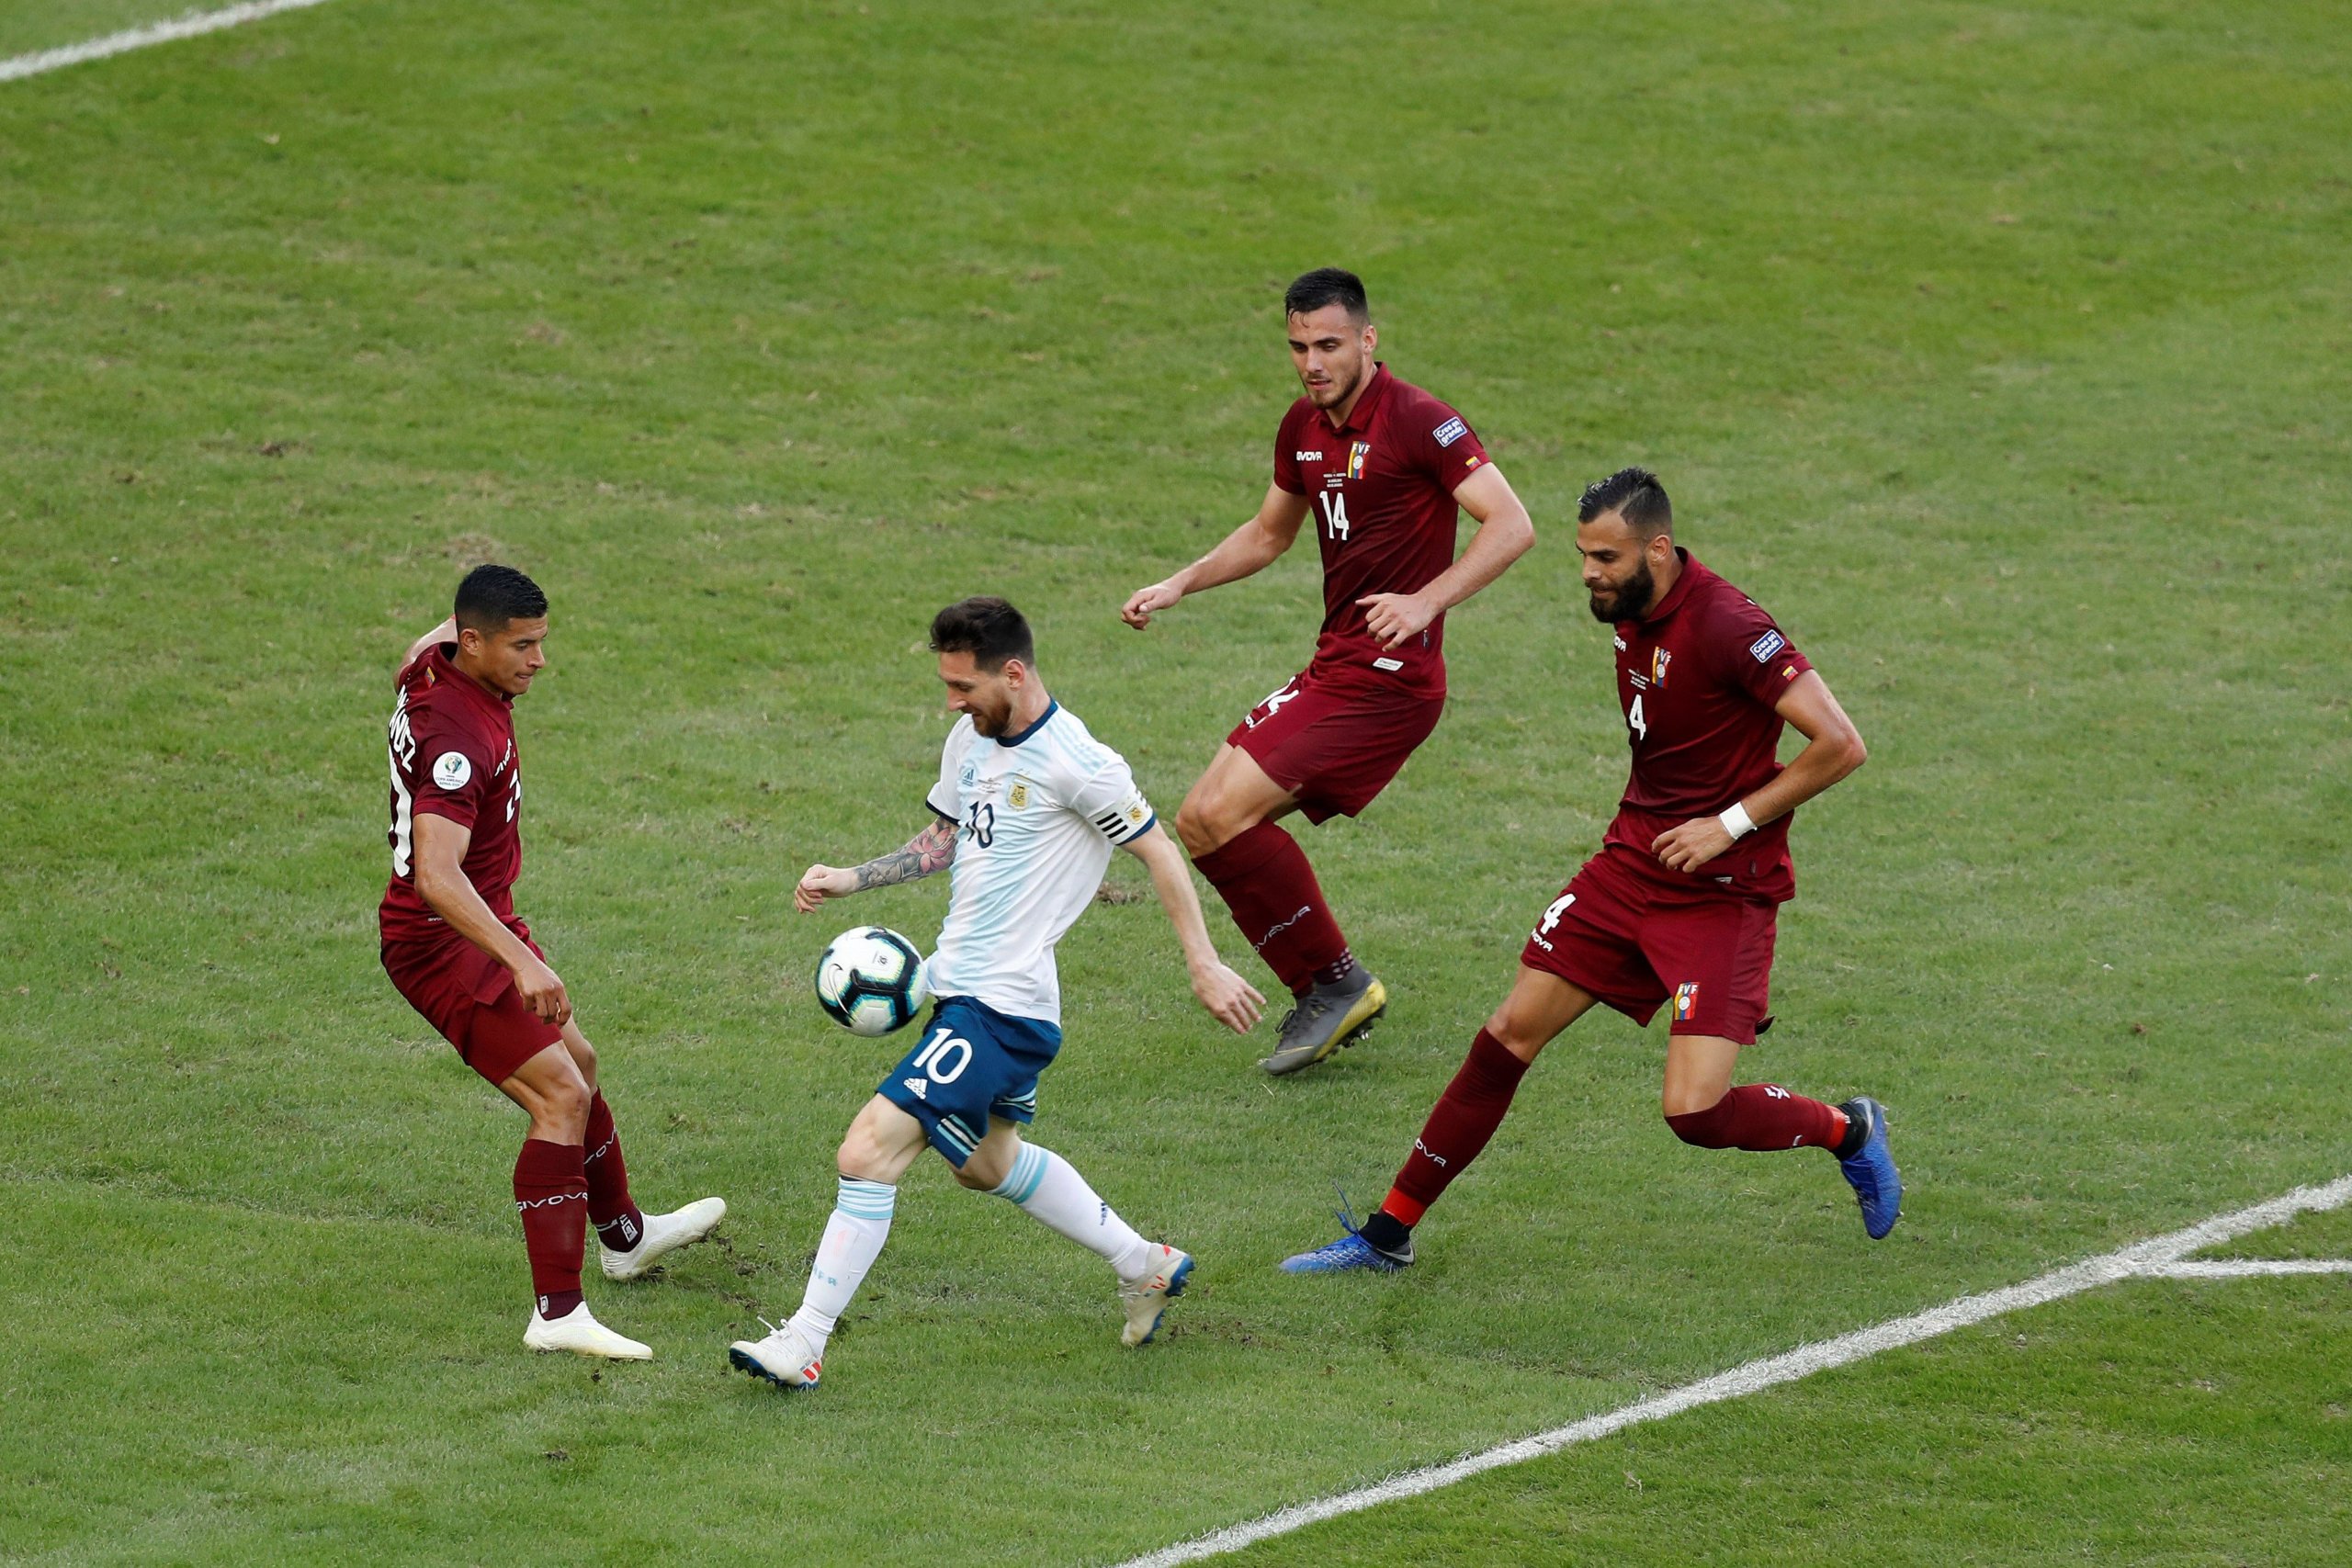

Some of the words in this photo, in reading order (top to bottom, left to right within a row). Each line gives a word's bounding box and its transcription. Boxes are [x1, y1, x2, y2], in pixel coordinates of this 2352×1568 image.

[1352, 443, 1371, 455] FVF
[1319, 491, 1350, 541] 14
[1753, 640, 1770, 654] Cree
[1767, 633, 1777, 642] en
[1758, 639, 1780, 660] grande
[1629, 694, 1647, 741] 4
[965, 800, 995, 850] 10
[1540, 893, 1577, 935] 4
[1677, 984, 1699, 996] FVF
[911, 1027, 973, 1085] 10
